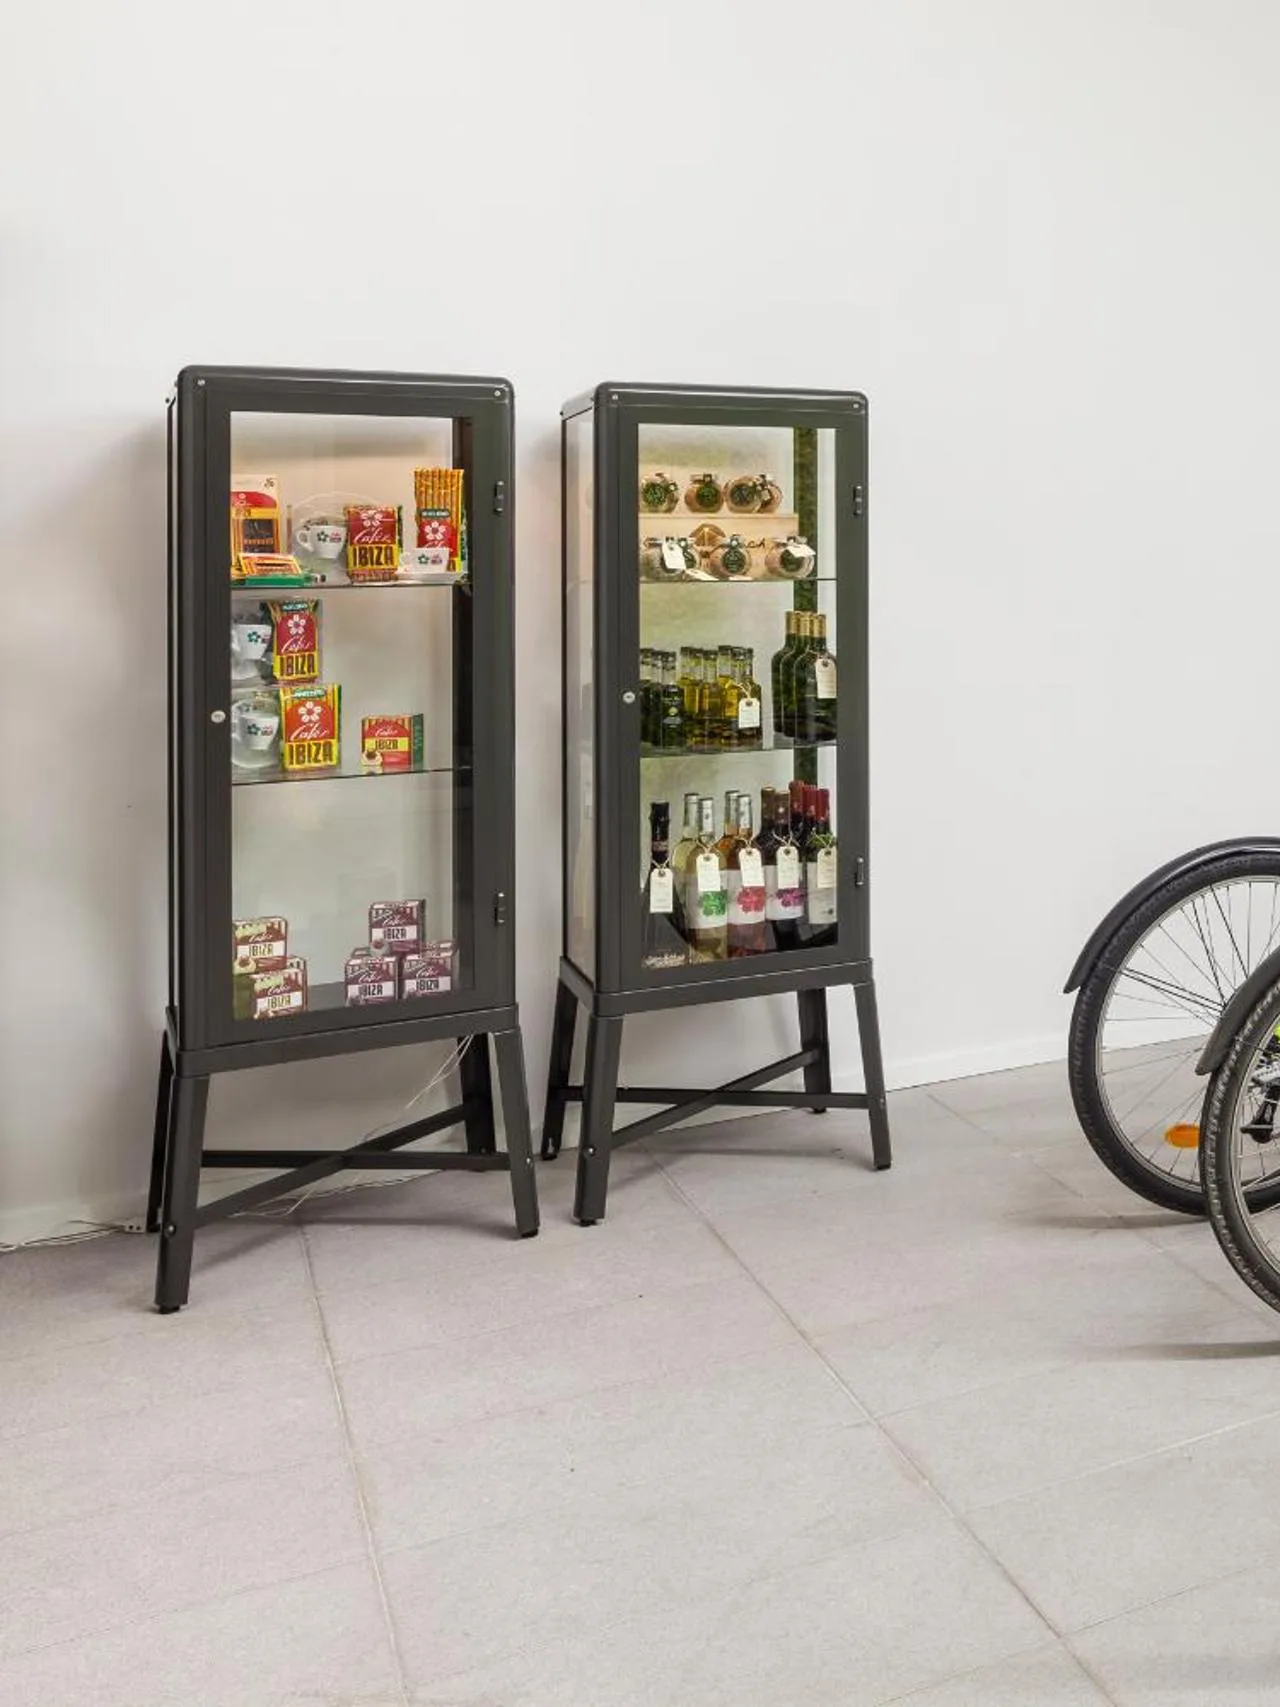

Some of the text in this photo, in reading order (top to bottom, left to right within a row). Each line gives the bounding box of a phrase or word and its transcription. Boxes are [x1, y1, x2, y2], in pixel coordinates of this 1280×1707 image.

[352, 545, 394, 567] IBIZA
[280, 654, 315, 676] IBIZA
[375, 739, 398, 750] IBIZA
[288, 741, 333, 766] IBIZA
[383, 928, 407, 940] IBIZA
[248, 944, 273, 957] IBIZA
[416, 979, 440, 991] IBIZA
[267, 995, 292, 1009] IBIZA
